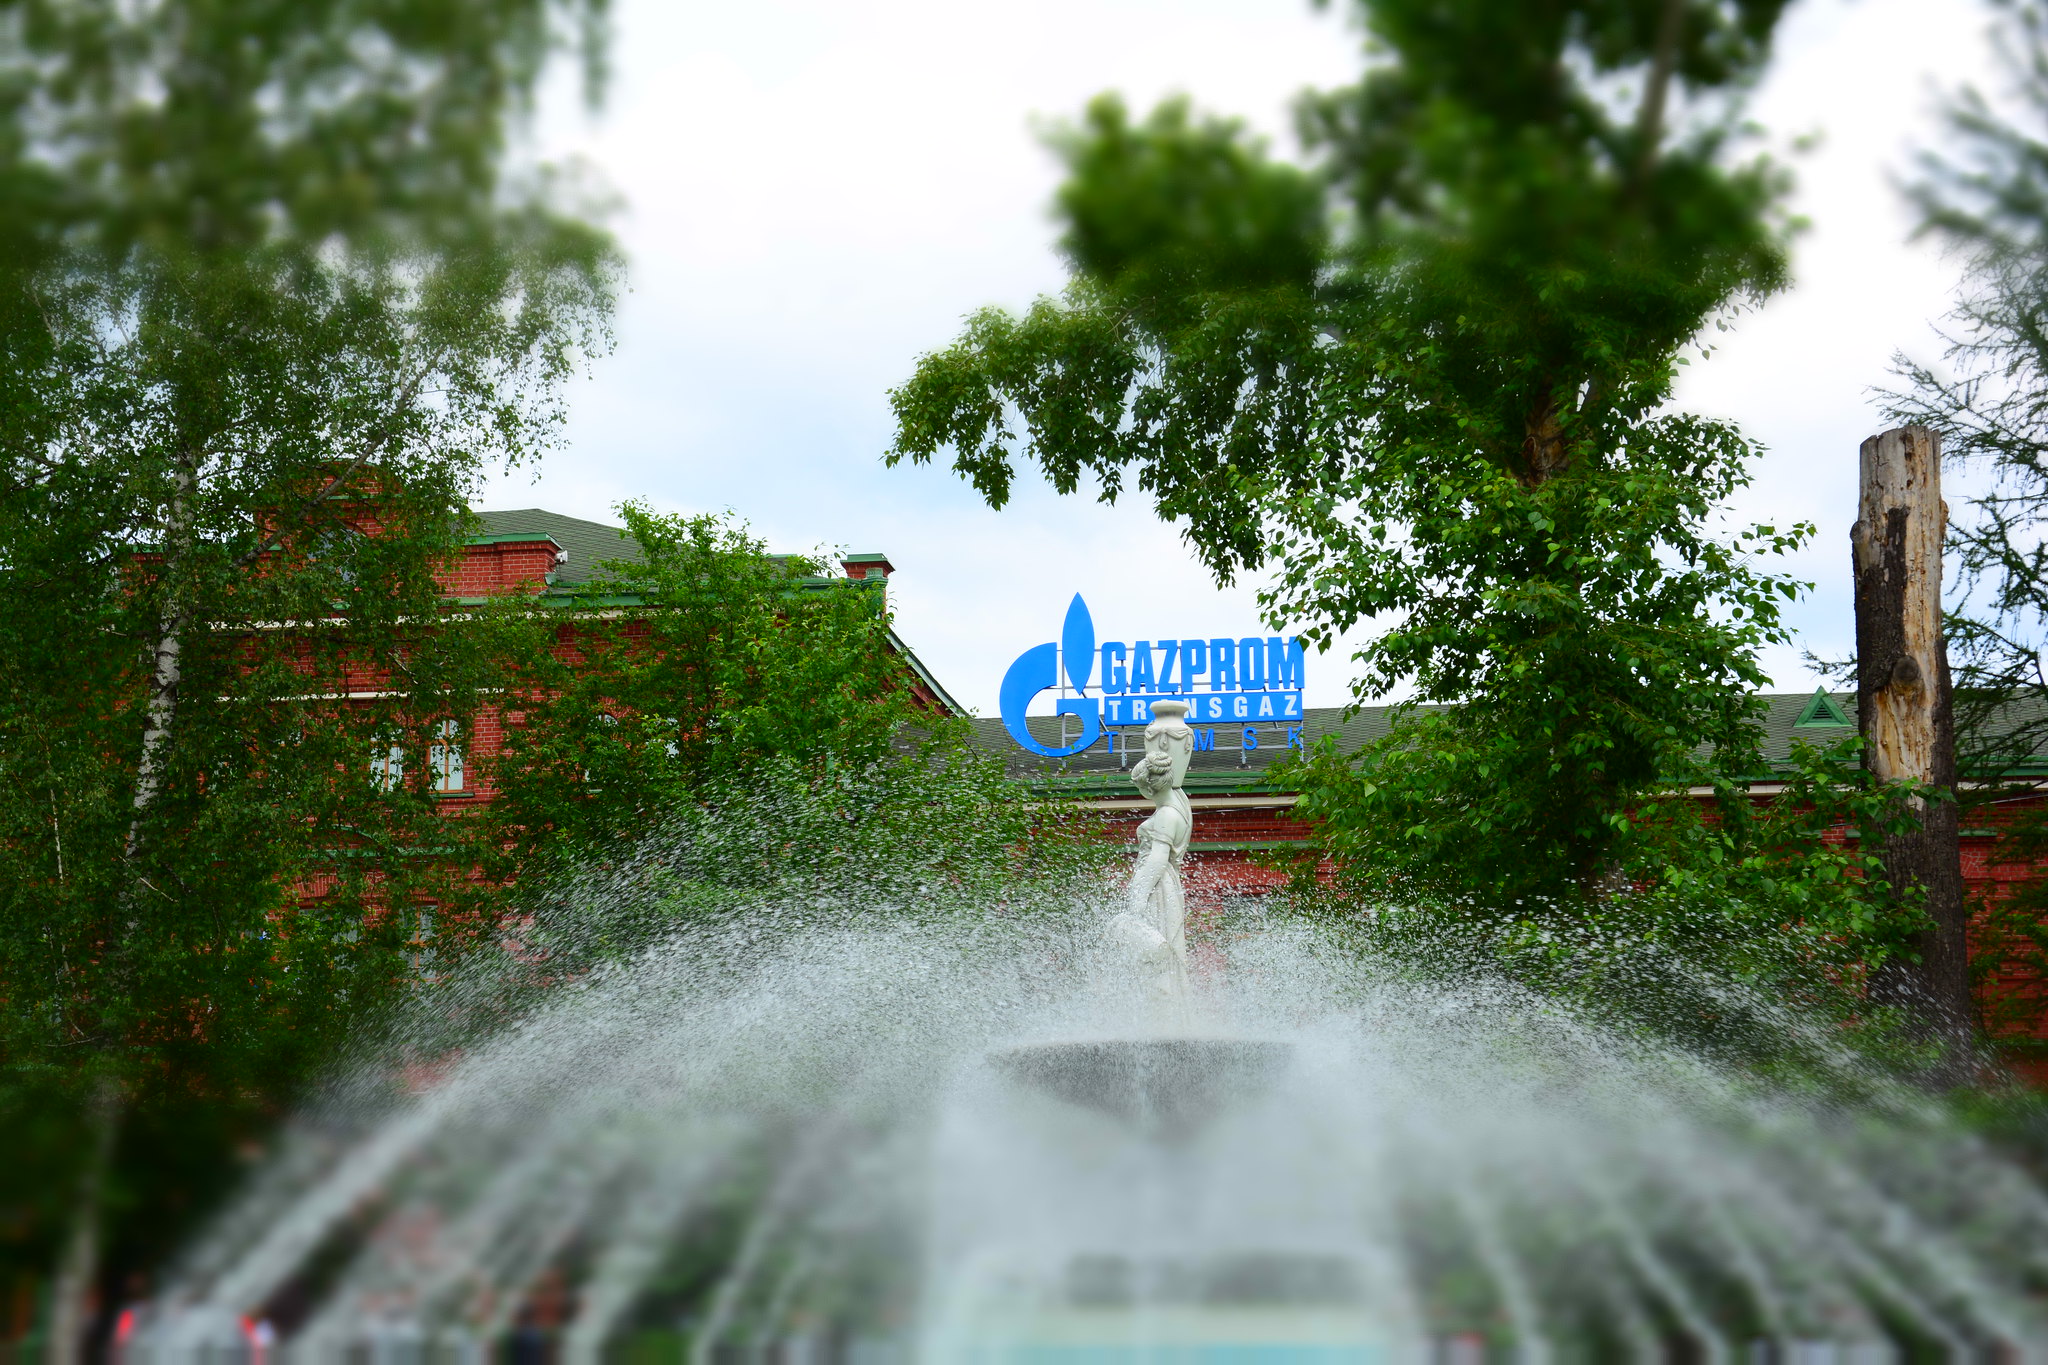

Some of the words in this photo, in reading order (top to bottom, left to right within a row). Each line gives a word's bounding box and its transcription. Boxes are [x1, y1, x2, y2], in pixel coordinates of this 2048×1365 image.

[1101, 636, 1305, 694] GAZPROM
[1108, 695, 1298, 721] TRNSGAZ
[1103, 726, 1304, 754] TMSK
